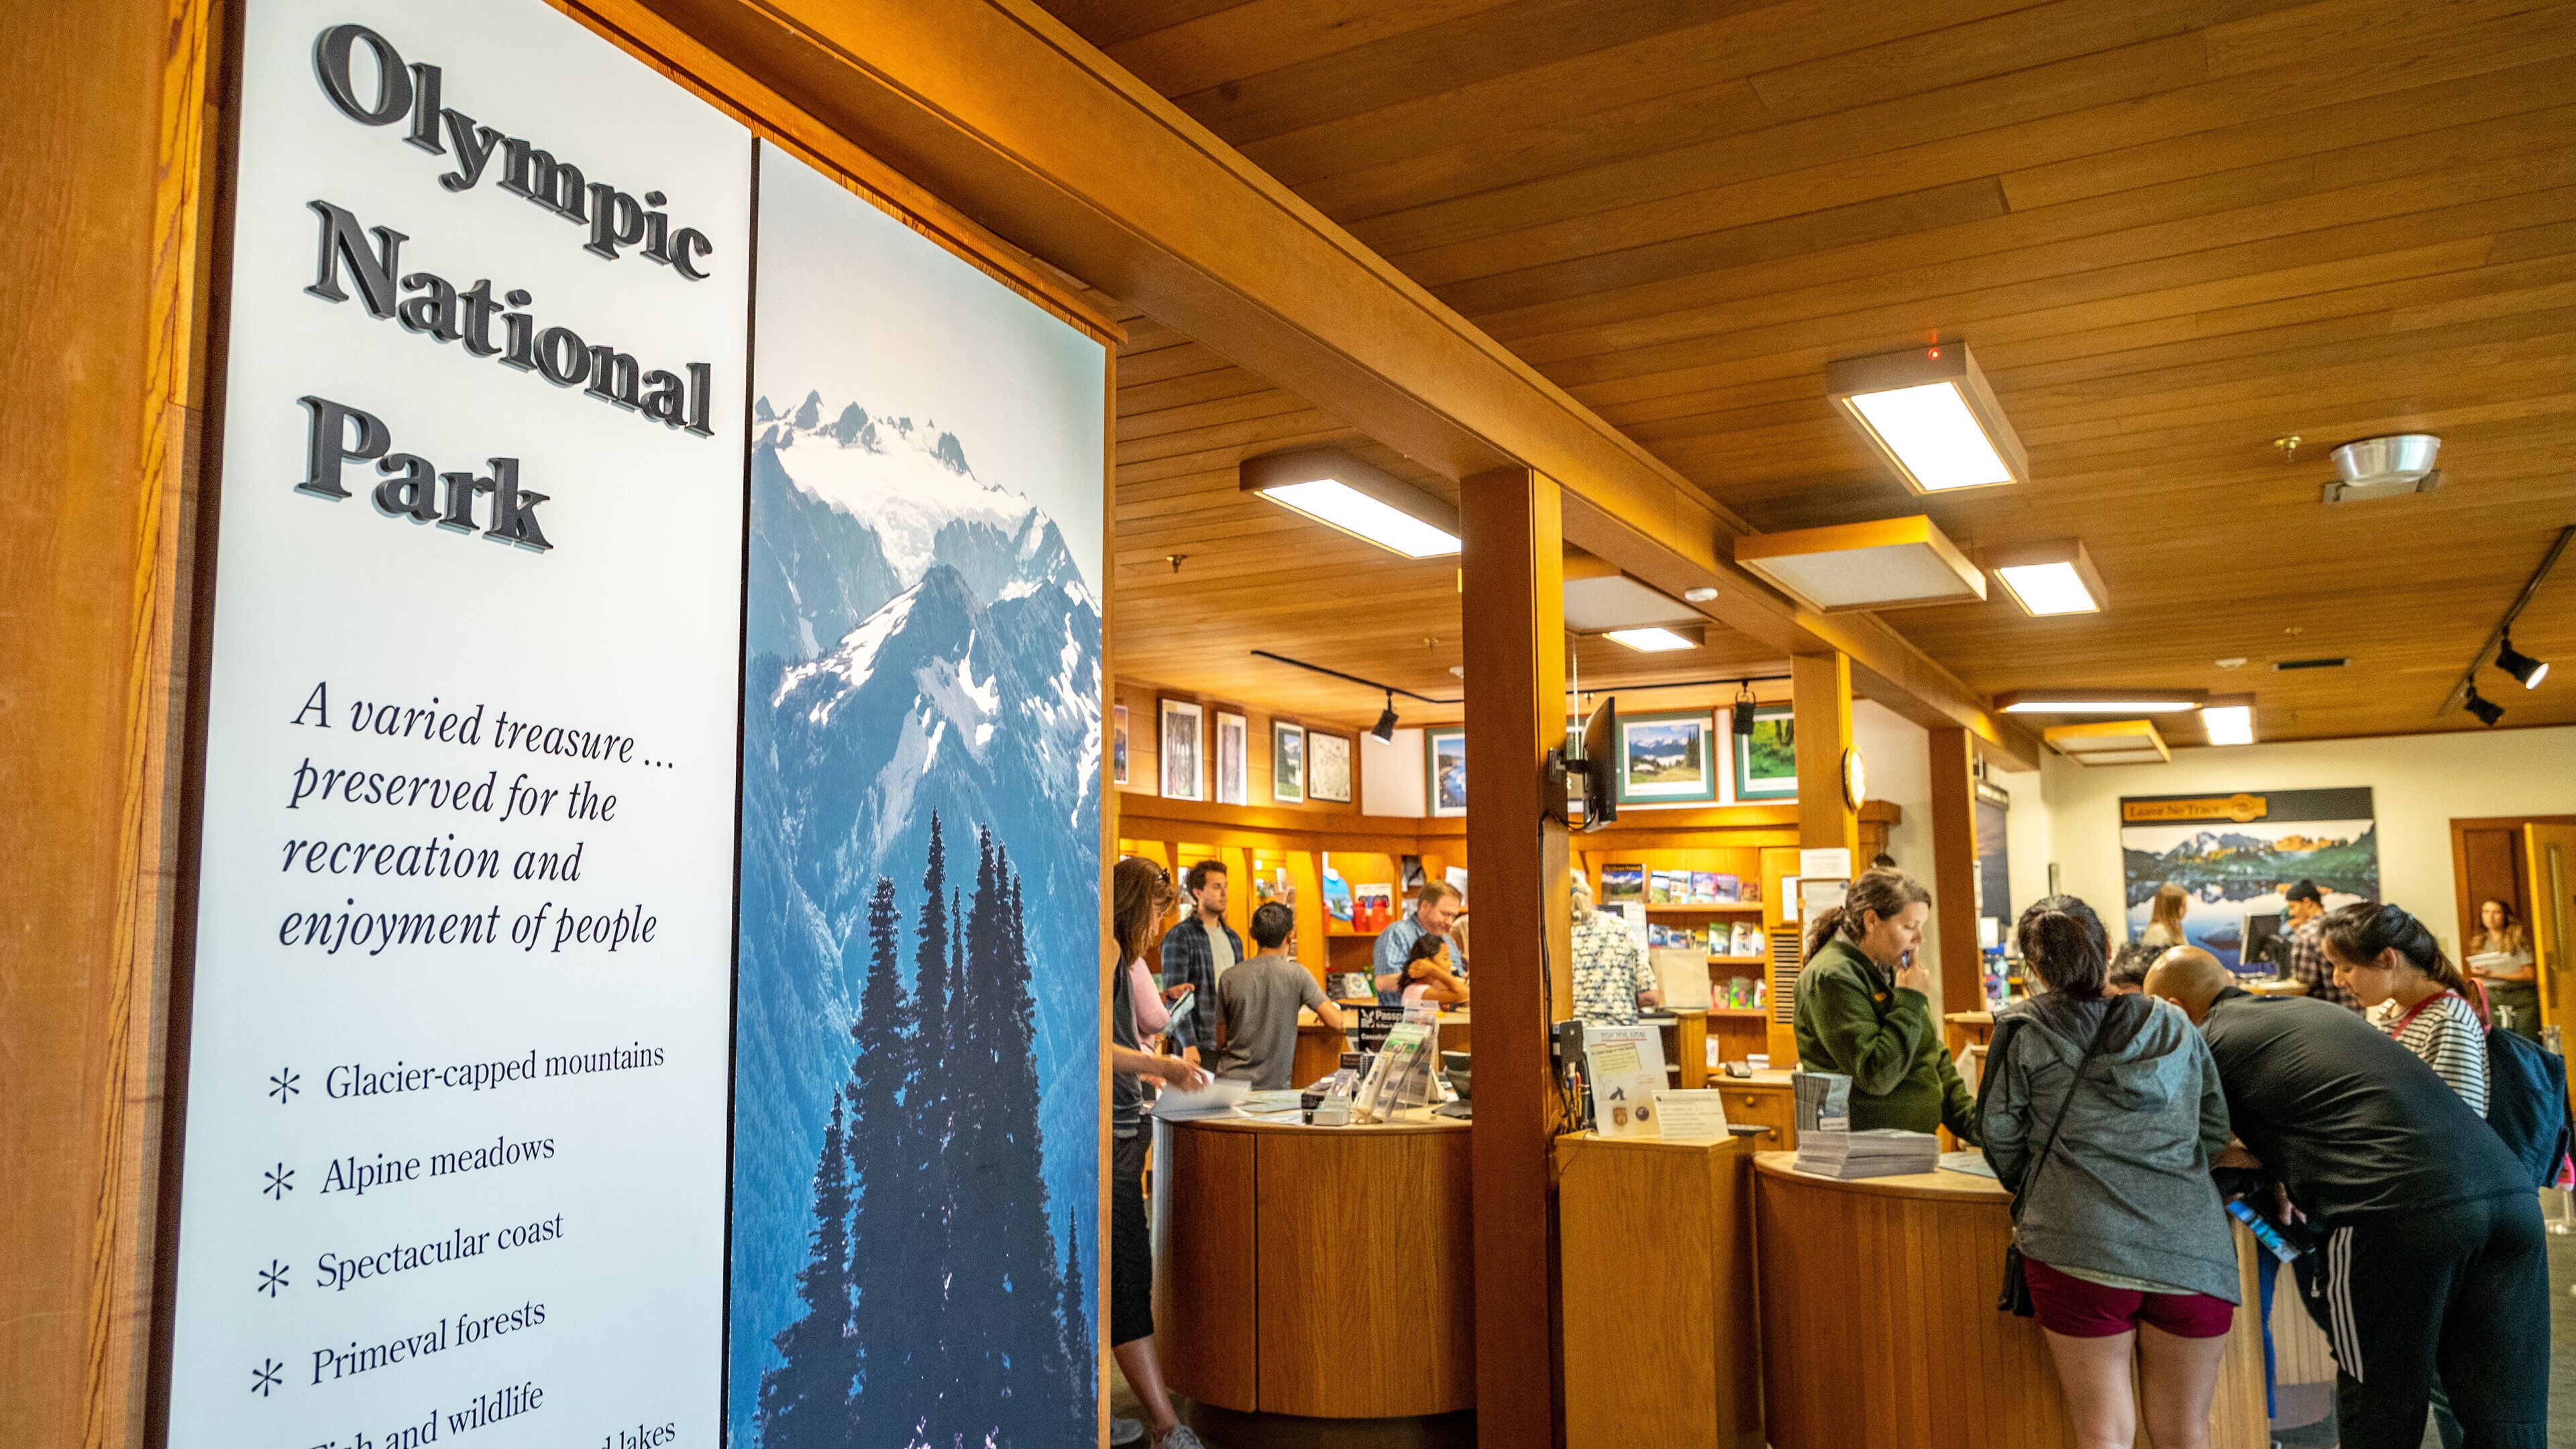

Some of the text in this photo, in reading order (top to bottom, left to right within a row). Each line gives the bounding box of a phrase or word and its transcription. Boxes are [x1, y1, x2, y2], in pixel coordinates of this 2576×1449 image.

[312, 22, 713, 282] Olympic
[303, 199, 716, 439] National
[294, 394, 555, 554] Park
[290, 680, 331, 729] A
[350, 696, 484, 745] varied
[494, 710, 635, 763] treasure
[286, 757, 617, 822] preserved for the
[282, 833, 584, 881] recreation and
[278, 898, 657, 957] enjoyment of people
[326, 1041, 665, 1099] Glacier-capped mountains
[320, 1135, 555, 1195] Alpine meadows
[316, 1212, 564, 1292] Spectacular coast
[311, 1299, 546, 1386] Primeval forests
[385, 1381, 544, 1449] and wildlife
[619, 1421, 676, 1449] lakes
